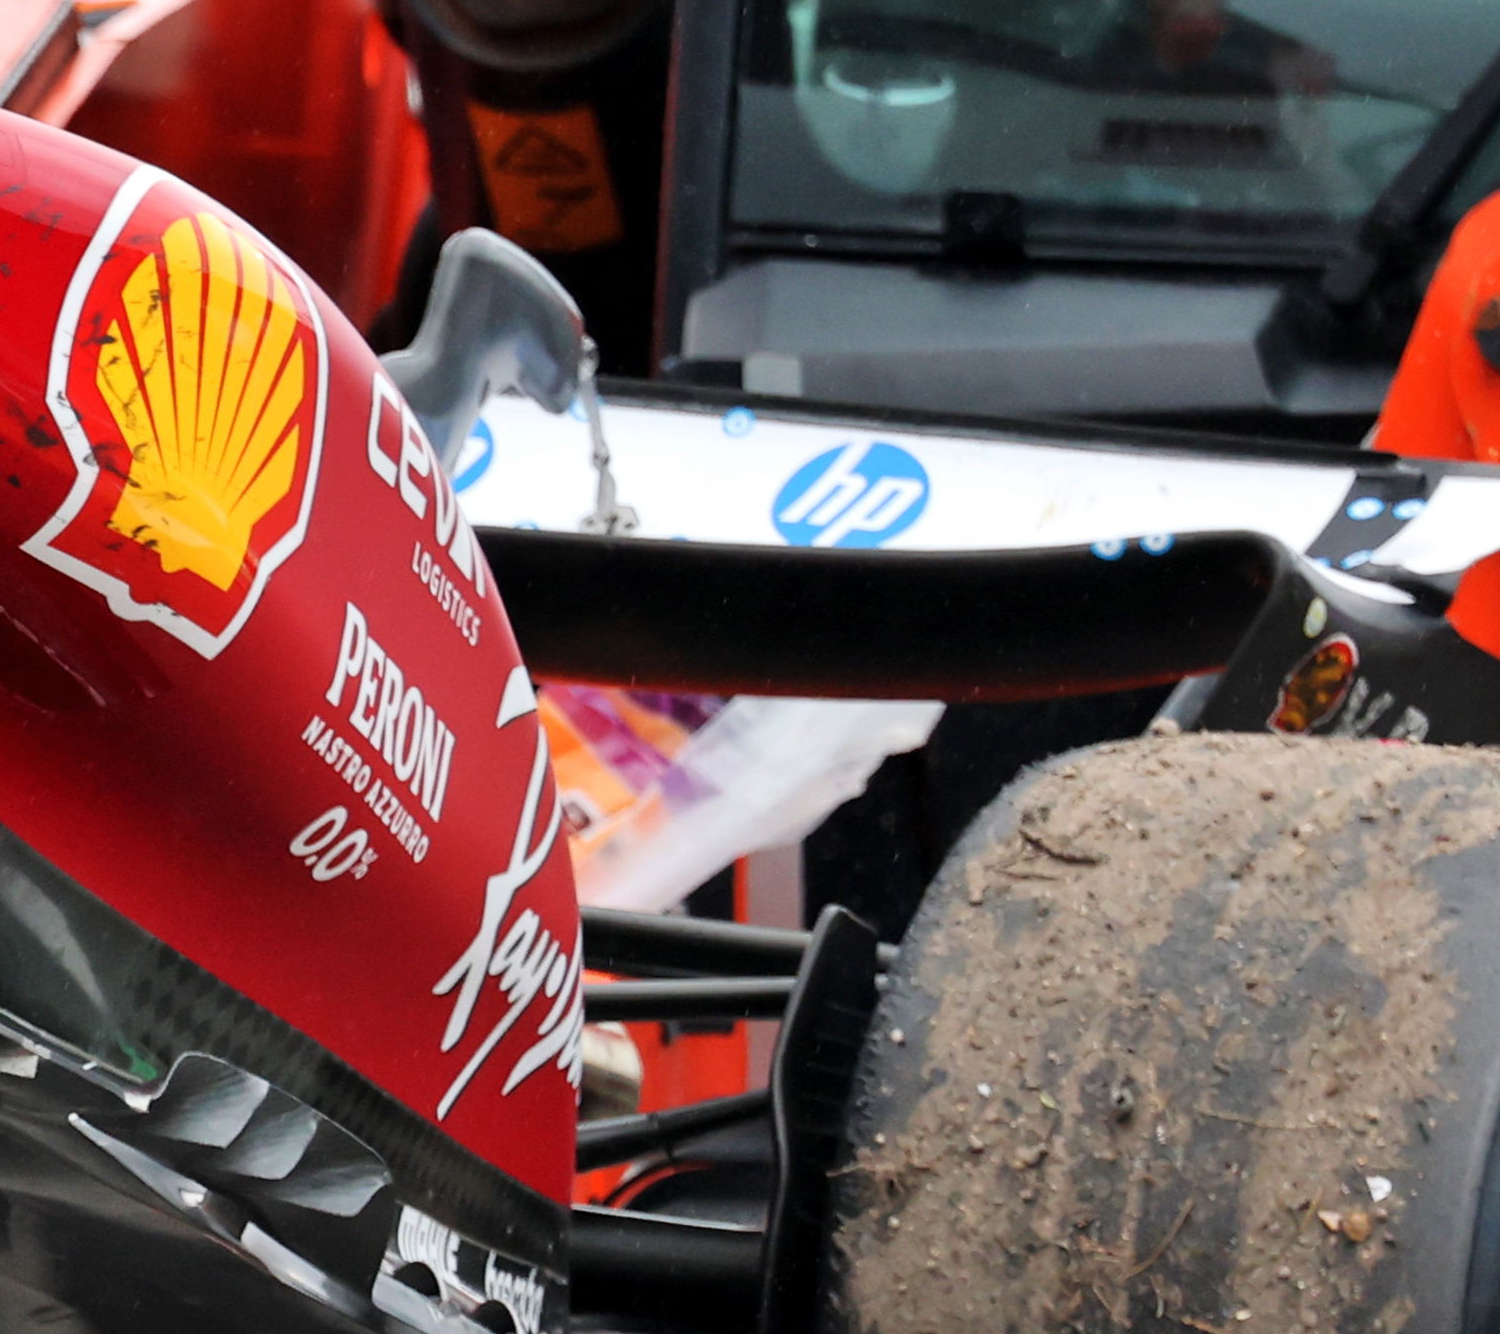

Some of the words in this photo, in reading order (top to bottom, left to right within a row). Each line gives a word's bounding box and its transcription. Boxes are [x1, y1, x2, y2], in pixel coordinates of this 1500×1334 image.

[778, 440, 925, 548] hp
[411, 540, 482, 647] LOGISTICS
[324, 600, 456, 824] PERONI
[288, 804, 379, 882] 0.0%
[300, 714, 372, 794] NASTRO
[363, 777, 430, 864] AZZURRO
